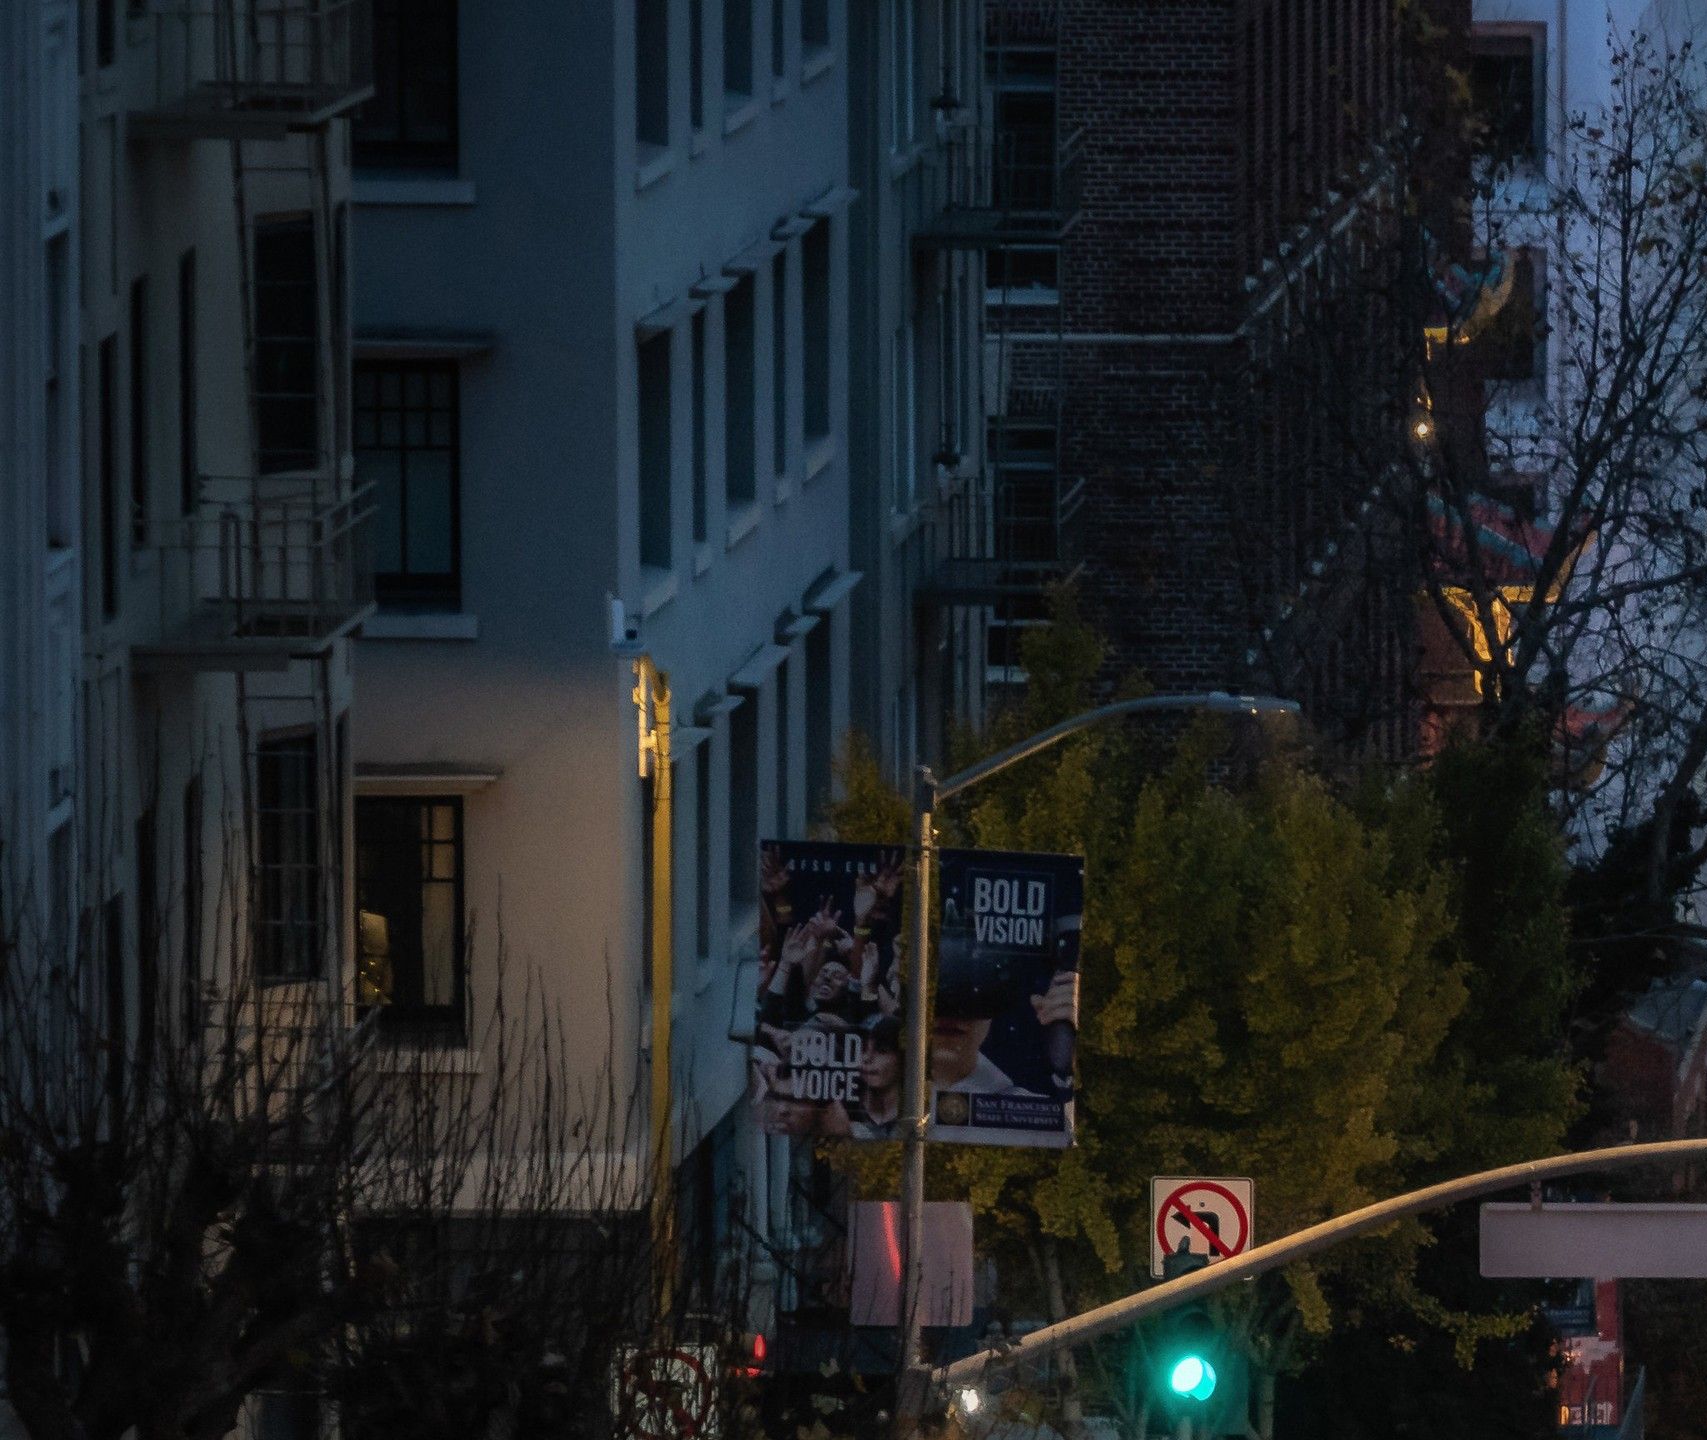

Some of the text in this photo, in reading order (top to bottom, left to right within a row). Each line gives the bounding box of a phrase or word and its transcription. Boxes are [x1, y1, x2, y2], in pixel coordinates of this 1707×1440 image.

[974, 878, 1046, 917] BOLD
[974, 917, 1044, 946] VISION
[791, 1032, 864, 1069] BOLD
[790, 1068, 860, 1102] VOICE
